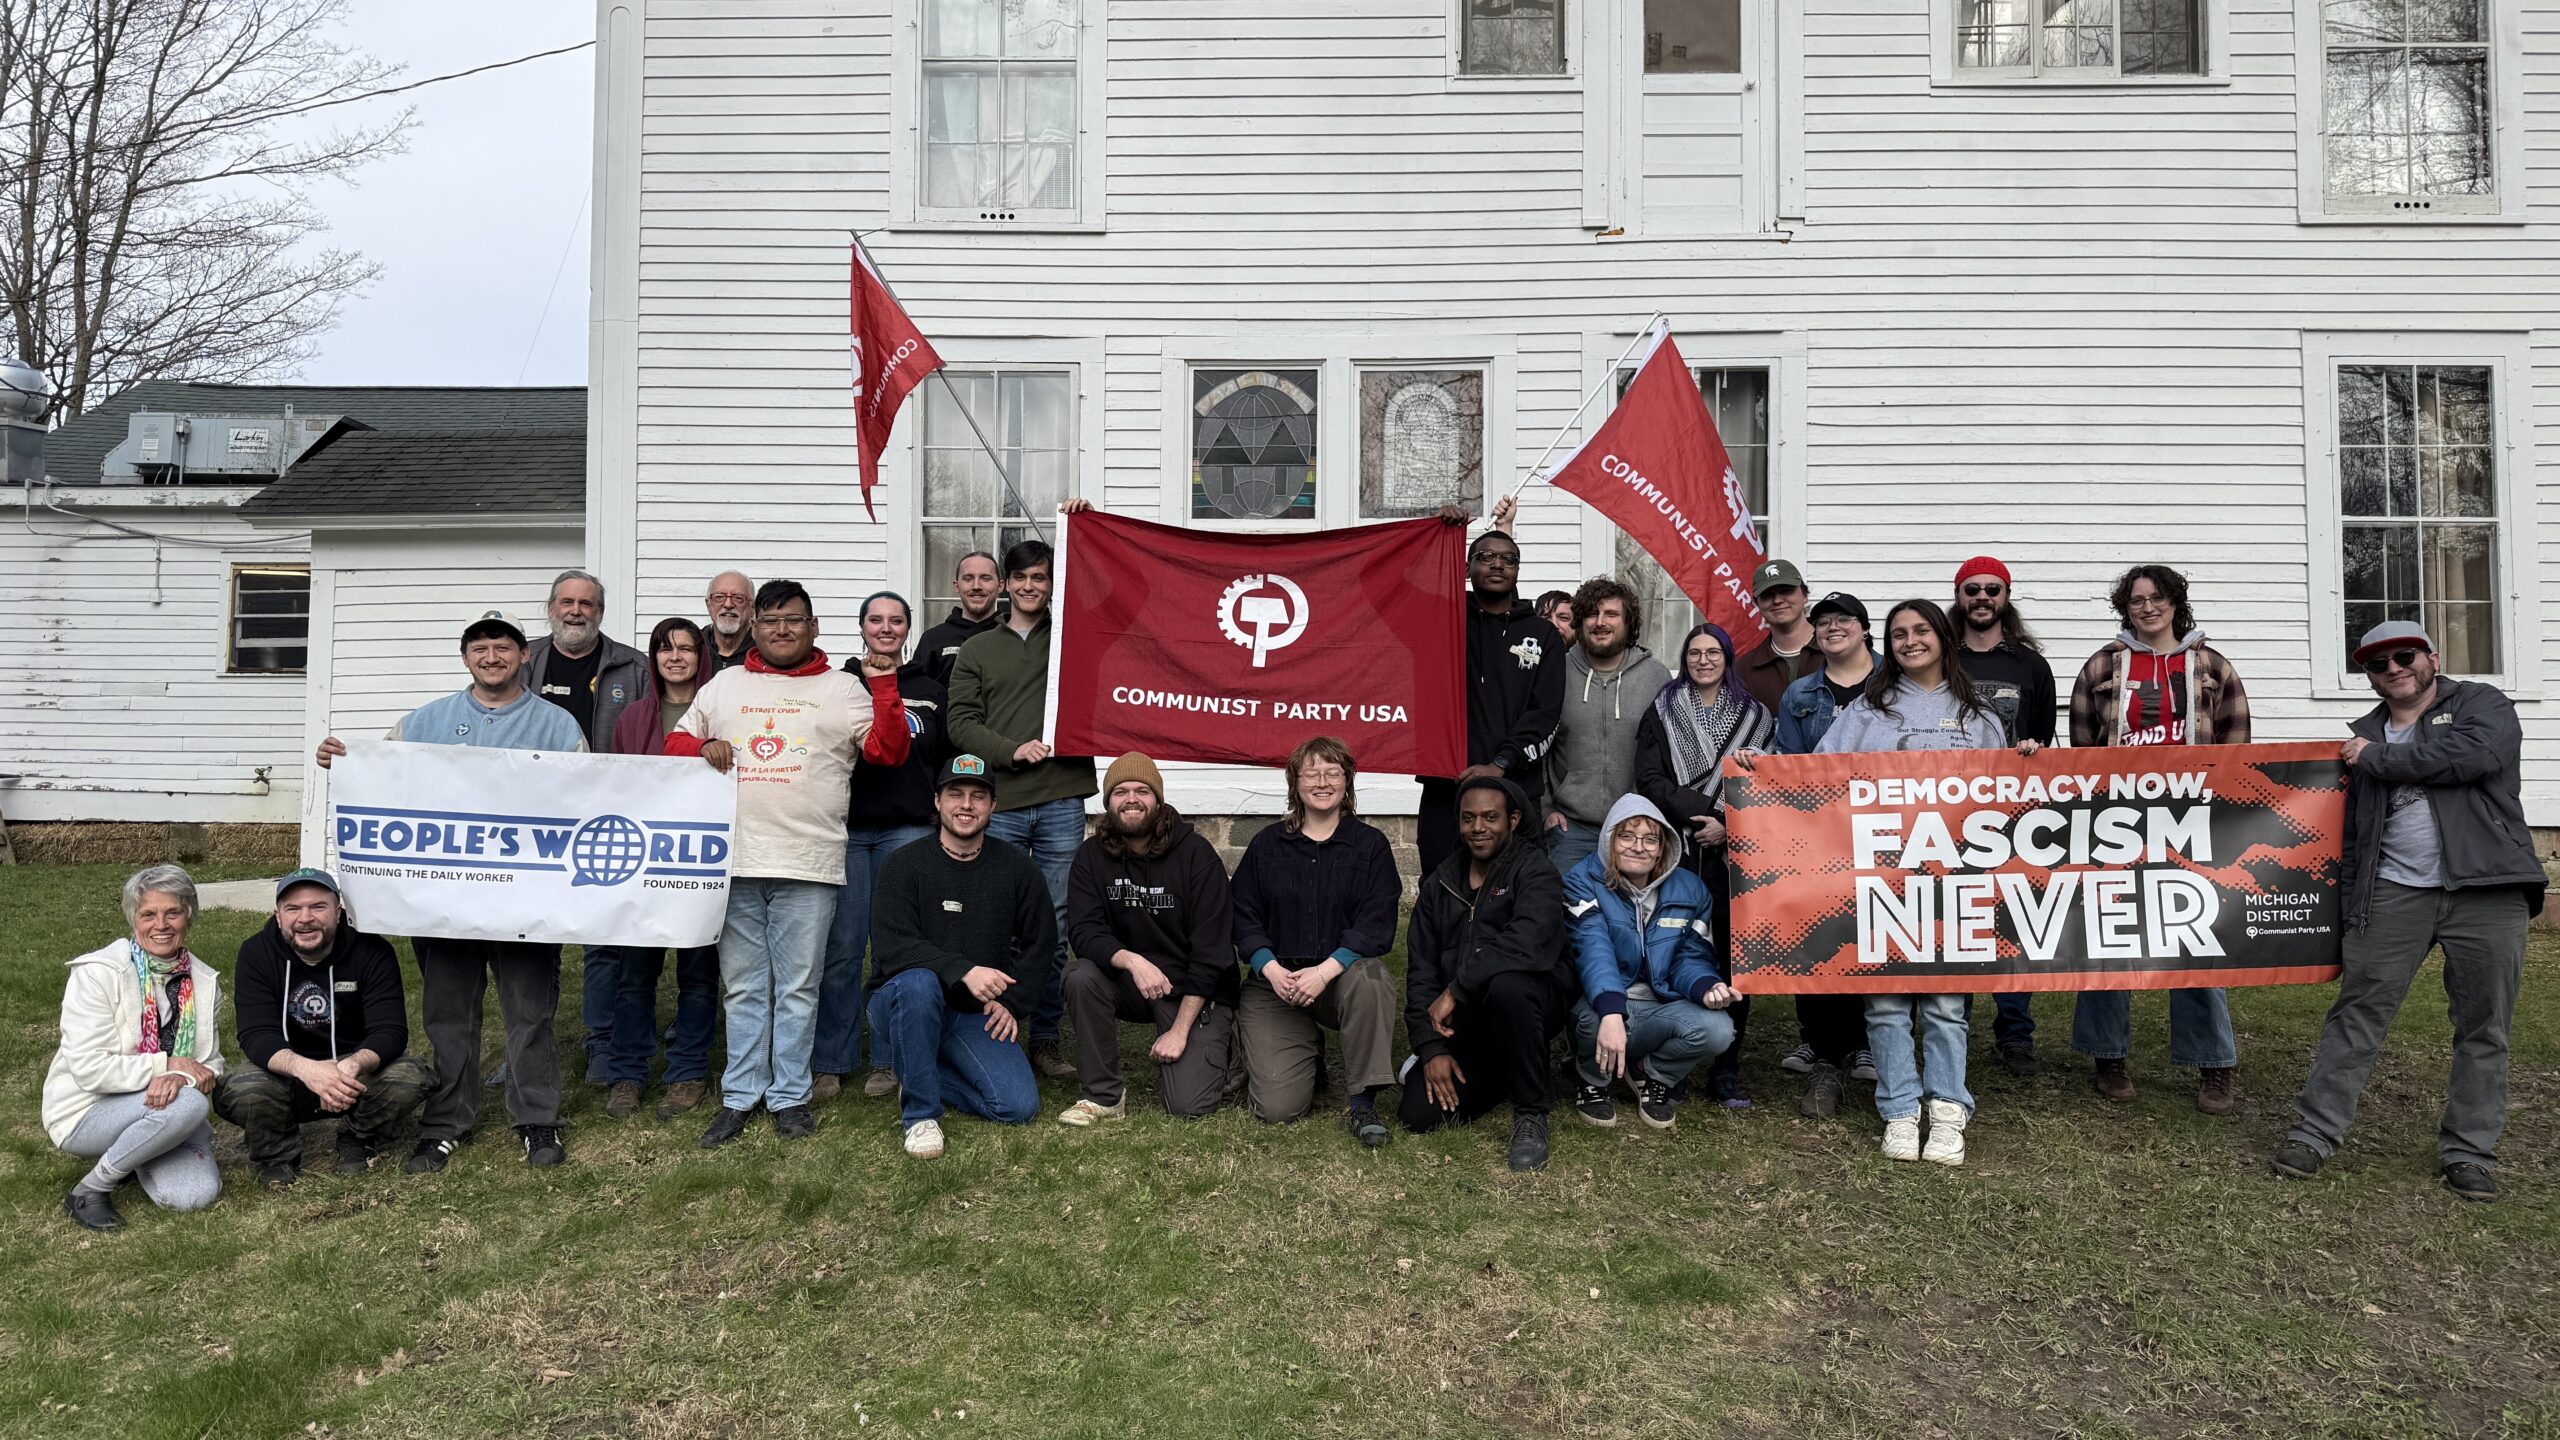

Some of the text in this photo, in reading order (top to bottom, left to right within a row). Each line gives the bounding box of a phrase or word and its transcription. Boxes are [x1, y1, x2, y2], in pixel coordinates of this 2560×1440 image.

[1600, 454, 1770, 631] COMMUNIST PARTY
[741, 706, 776, 714] DETROIT
[1112, 686, 1408, 723] COMMUNIST PARTY USA
[1941, 728, 1972, 736] Contines
[2122, 725, 2167, 747] TAND
[1849, 771, 2213, 806] DEMOCRACY NOW,
[1850, 806, 2212, 870] FASCISM
[336, 814, 728, 887] PEOPLE'S WORLD
[340, 864, 513, 882] CONTINUING THE DAILY WORKER
[643, 880, 699, 889] FOUNDED
[2245, 893, 2319, 906] MICHIGAN
[1855, 869, 2227, 964] NEVER
[2246, 909, 2312, 922] DISTRICT
